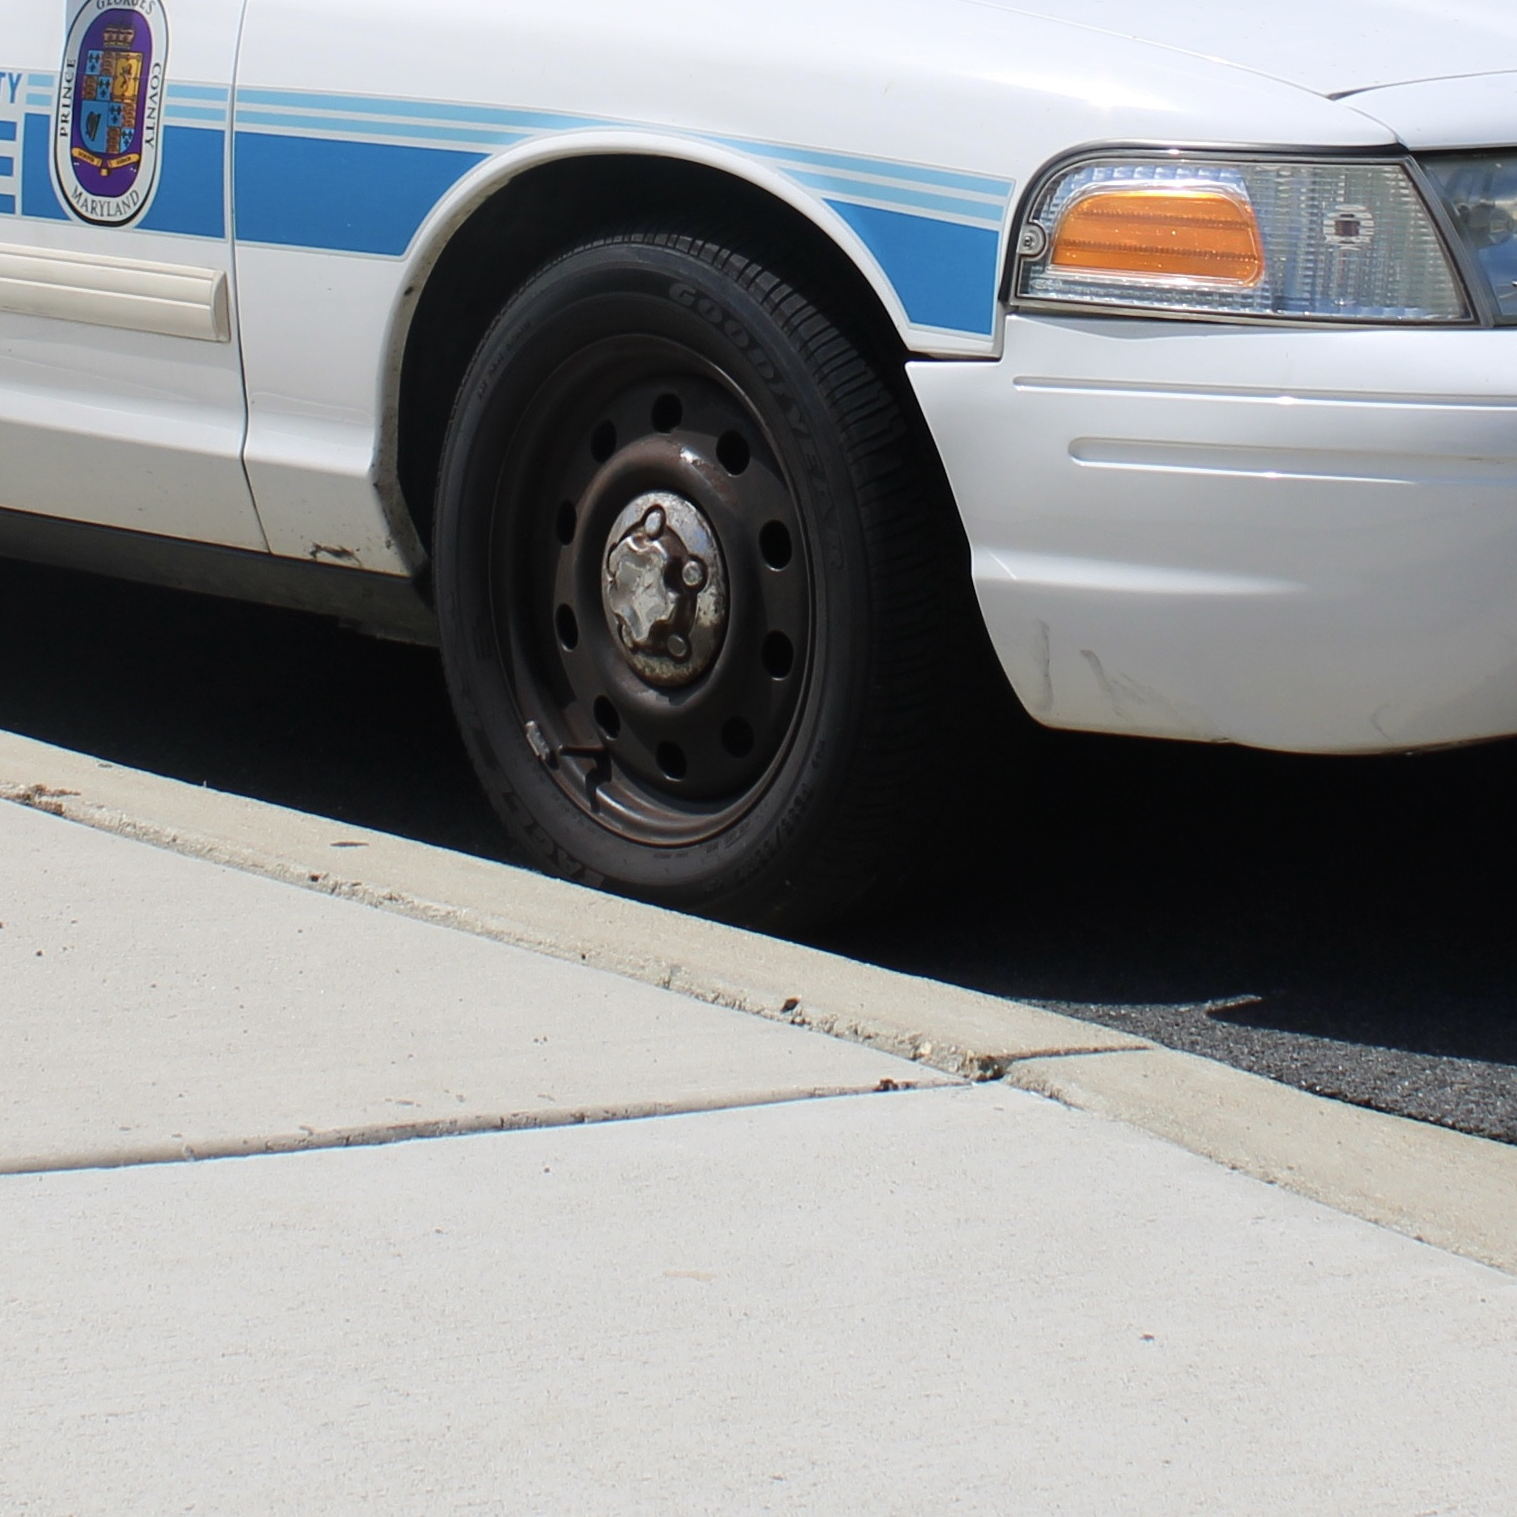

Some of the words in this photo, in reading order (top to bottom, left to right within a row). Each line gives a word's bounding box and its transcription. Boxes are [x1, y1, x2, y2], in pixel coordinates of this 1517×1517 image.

[59, 58, 77, 138] PRINCE
[71, 185, 140, 217] MARYLAND
[668, 282, 847, 568] GOODYEAR
